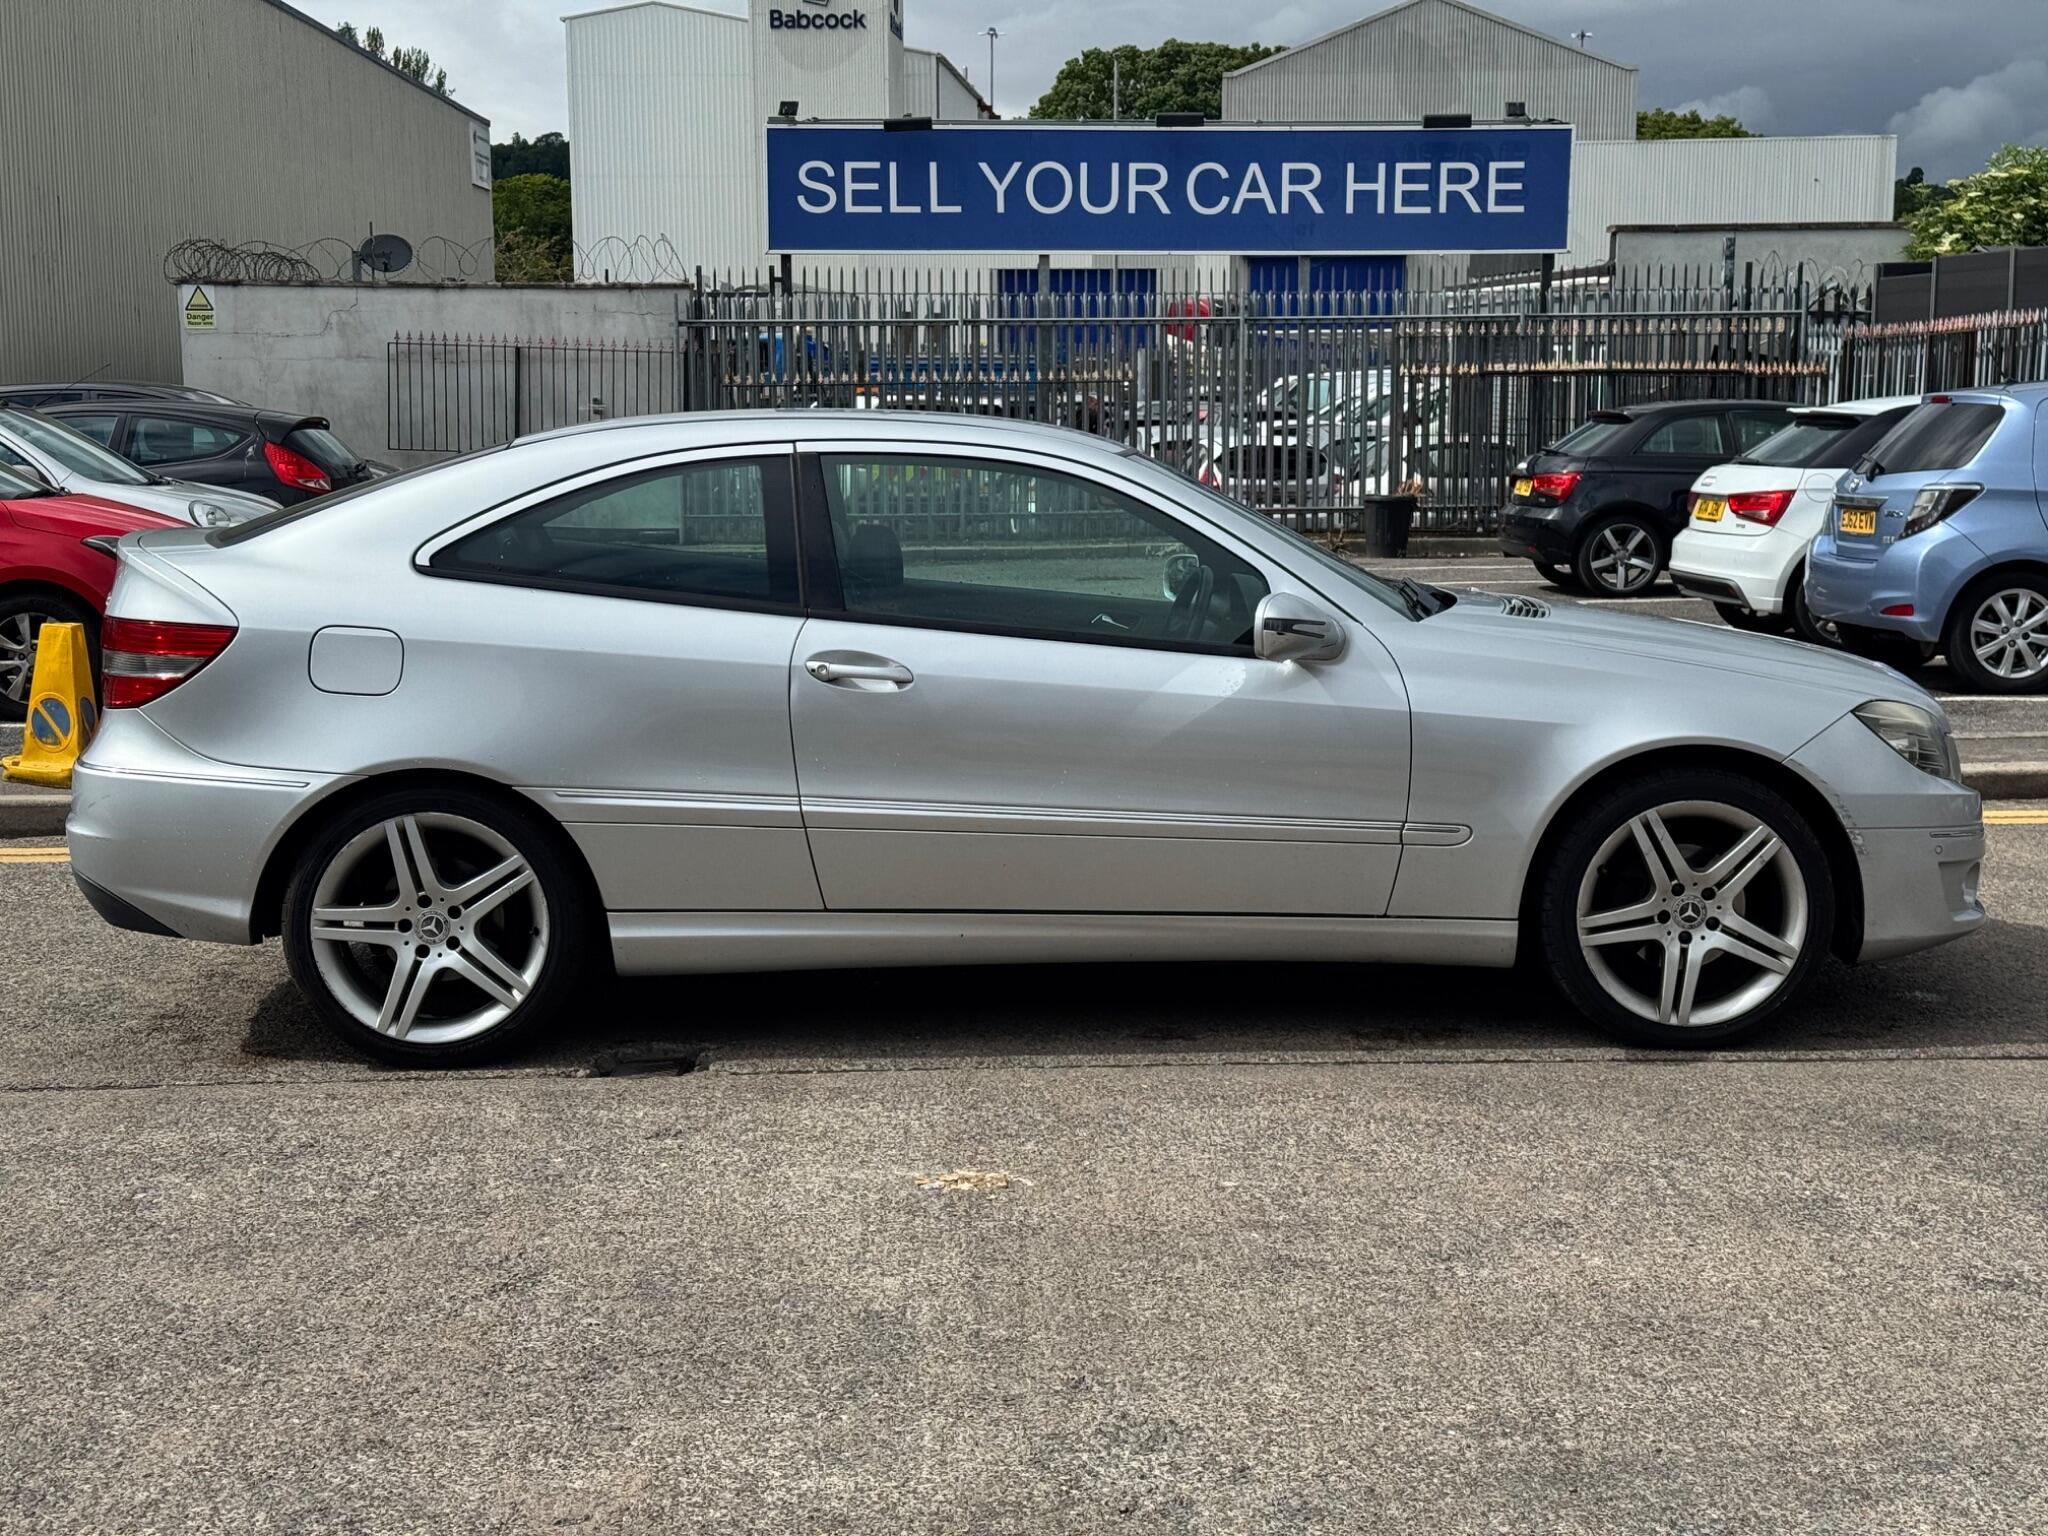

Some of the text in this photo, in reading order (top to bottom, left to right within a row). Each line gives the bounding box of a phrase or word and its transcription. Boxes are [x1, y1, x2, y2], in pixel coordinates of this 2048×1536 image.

[769, 9, 867, 30] Babcock
[797, 160, 1526, 215] SELL YOUR CAR HERE
[186, 313, 214, 321] Danger
